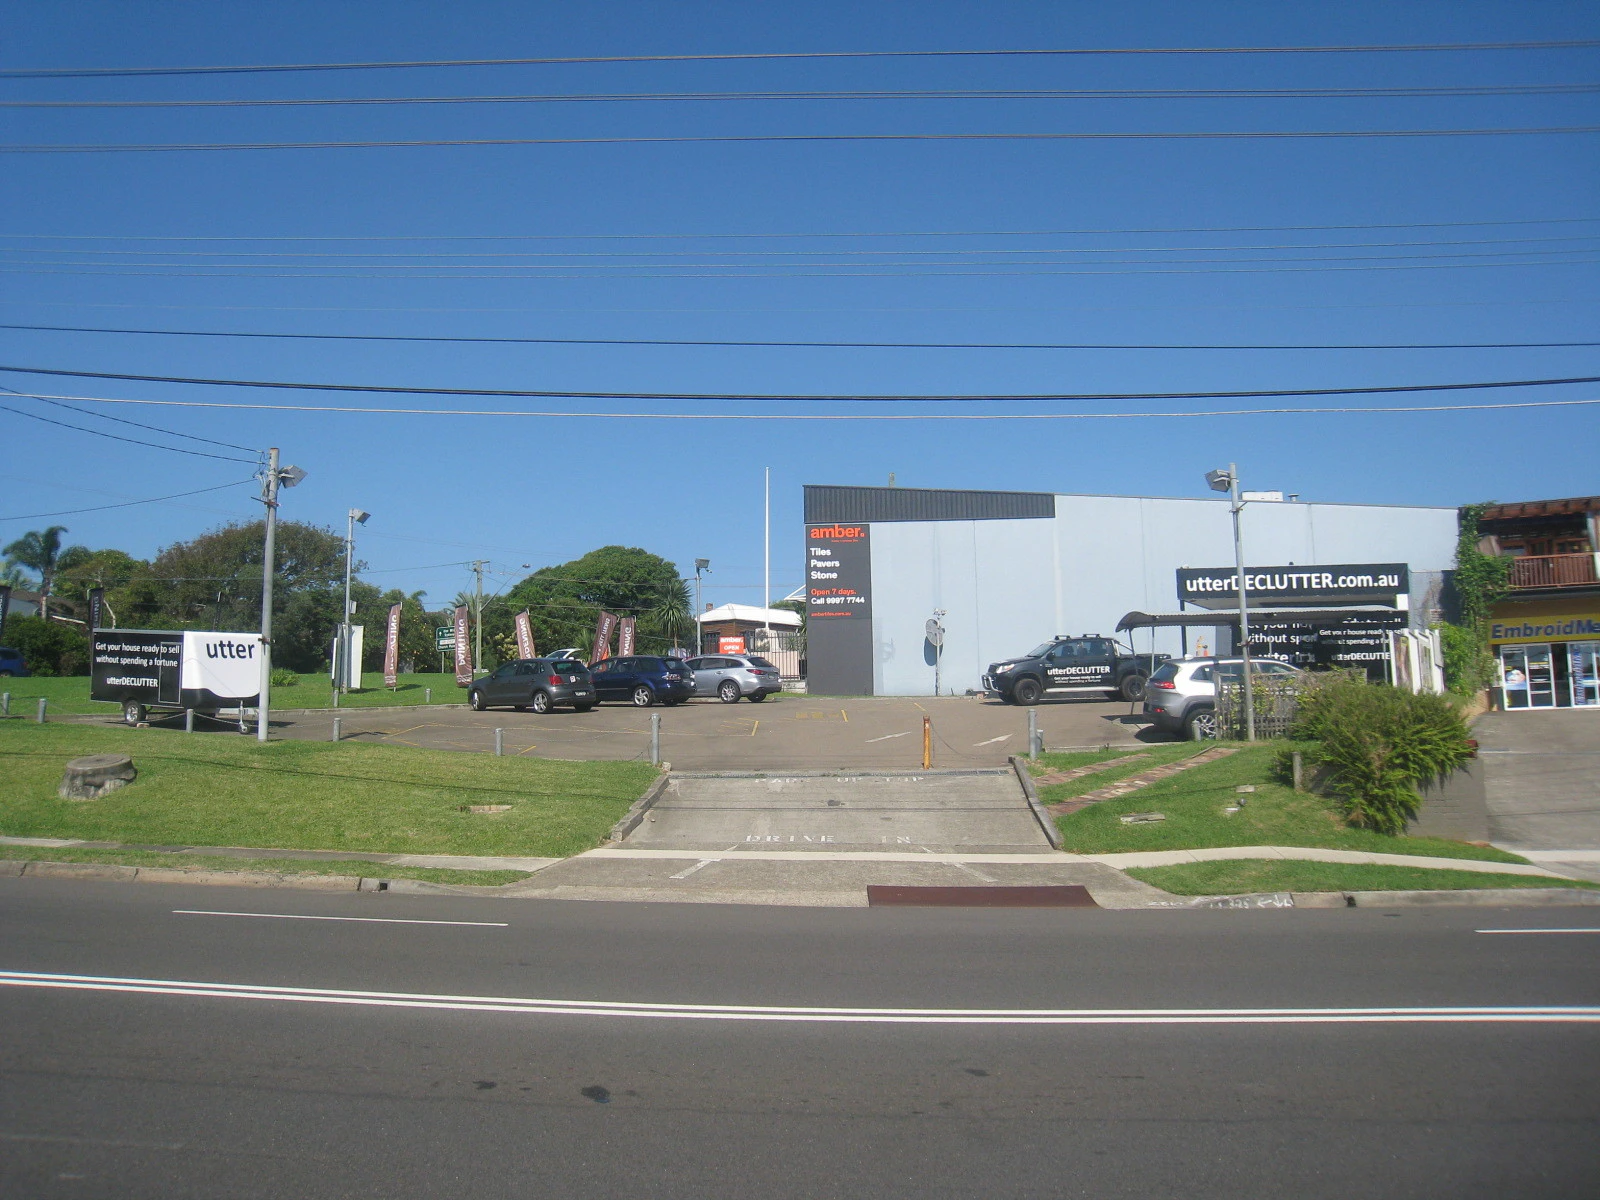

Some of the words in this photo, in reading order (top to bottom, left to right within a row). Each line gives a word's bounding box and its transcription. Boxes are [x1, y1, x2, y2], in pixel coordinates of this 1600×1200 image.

[810, 547, 832, 556] Tiles
[811, 559, 840, 568] Pavers
[811, 571, 838, 579] Stone
[811, 588, 830, 596] Open
[95, 642, 106, 651] Get
[107, 644, 121, 652] your
[122, 643, 140, 652] house
[142, 644, 159, 654] ready
[168, 645, 180, 654] sell
[206, 640, 255, 659] utter
[96, 655, 119, 664] without
[120, 656, 148, 667] spending
[154, 658, 178, 667] fortune
[1331, 652, 1391, 661] utterDECLUTTE
[1047, 665, 1111, 675] utterDECLUTTER
[107, 676, 159, 687] utterDECLUTTER
[881, 836, 911, 844] IN
